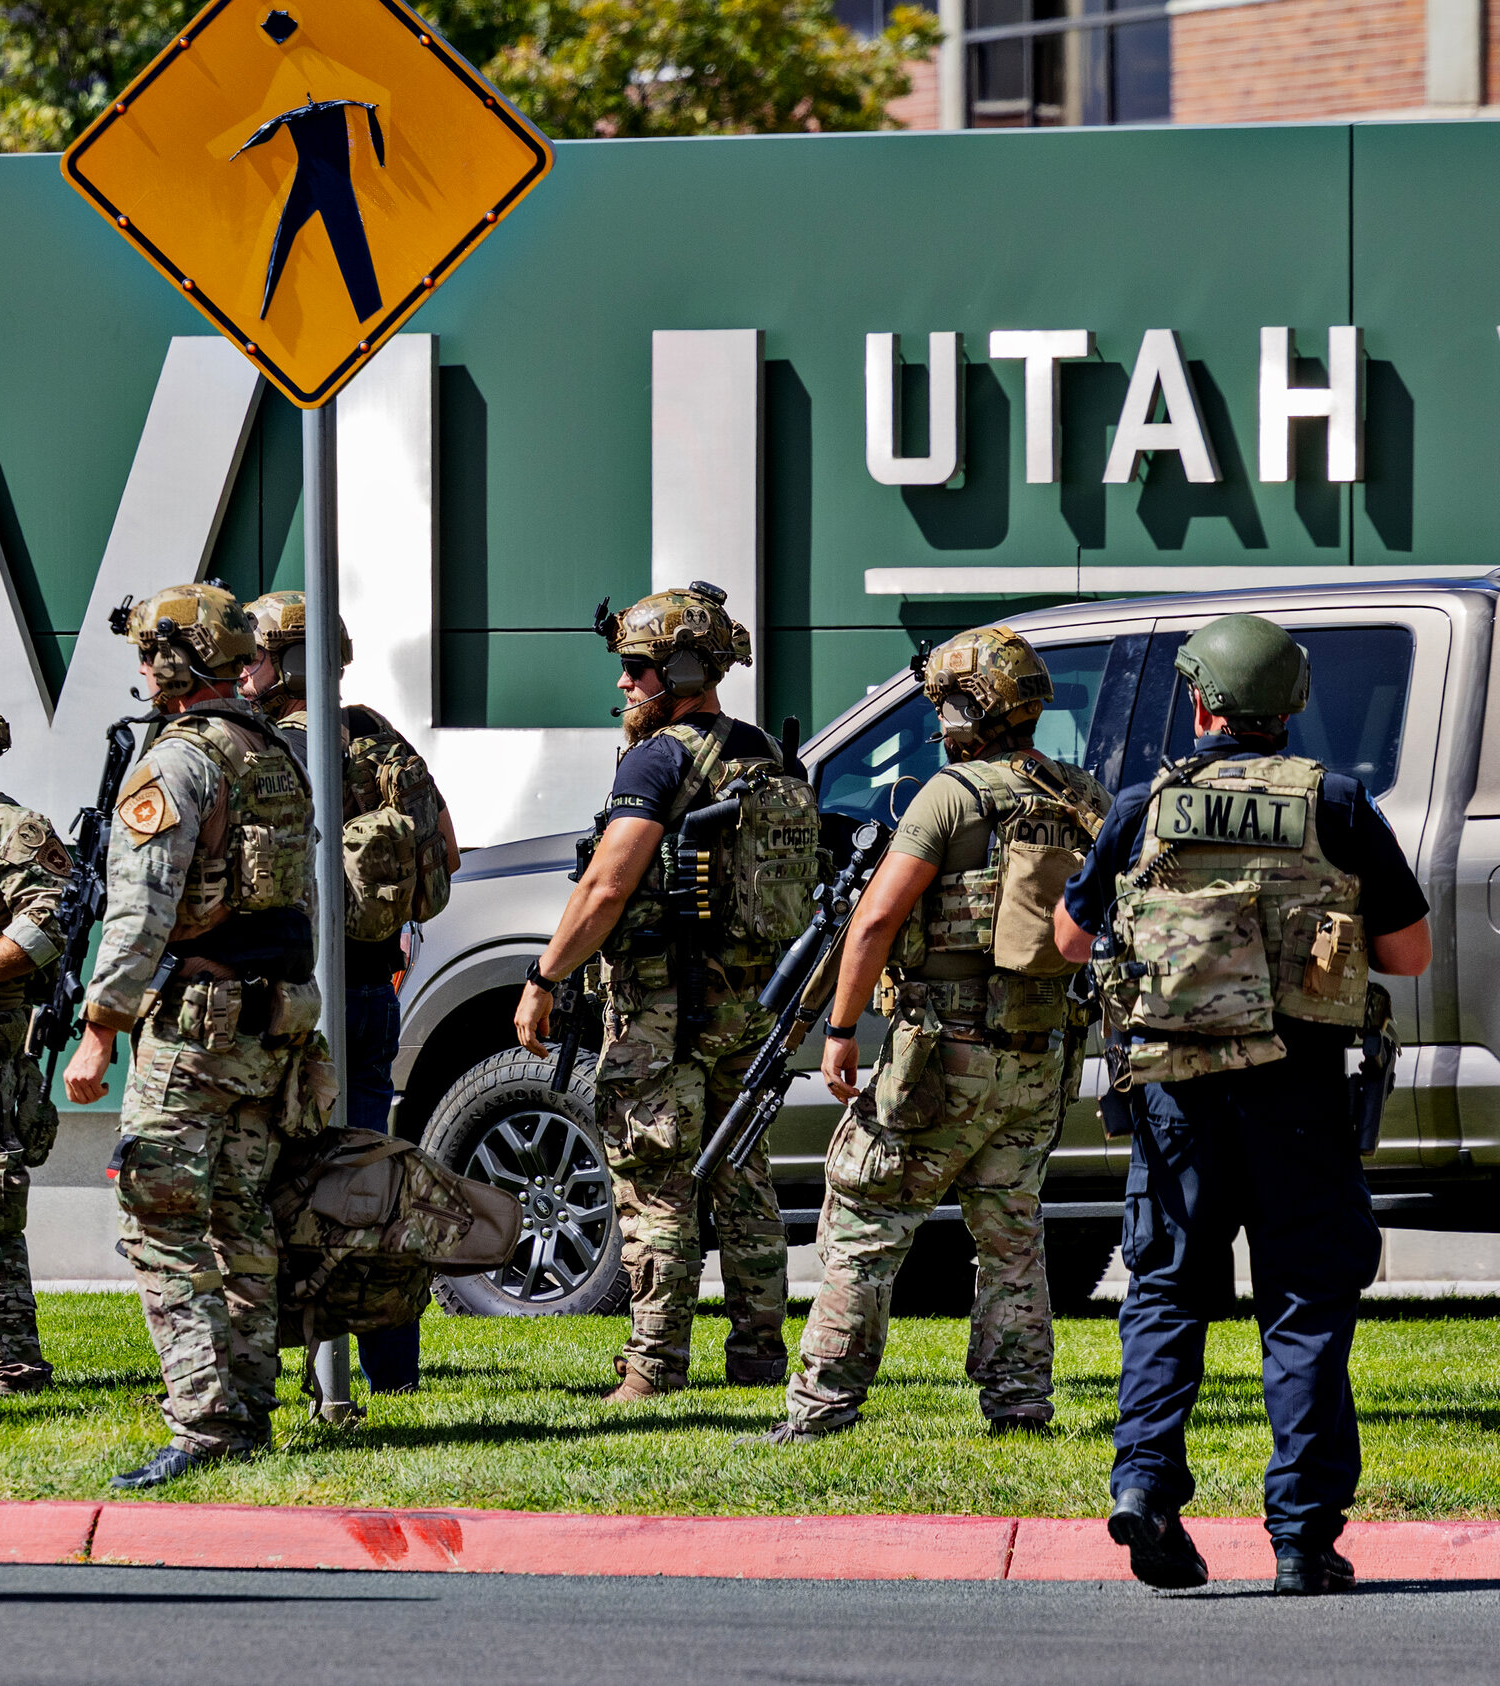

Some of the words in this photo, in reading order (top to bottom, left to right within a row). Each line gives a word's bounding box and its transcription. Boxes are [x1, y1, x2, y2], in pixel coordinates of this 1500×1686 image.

[866, 325, 1363, 485] UTAH
[259, 775, 294, 794] POLICE
[899, 823, 920, 837] LICE
[1173, 793, 1290, 842] S.W.A.T.
